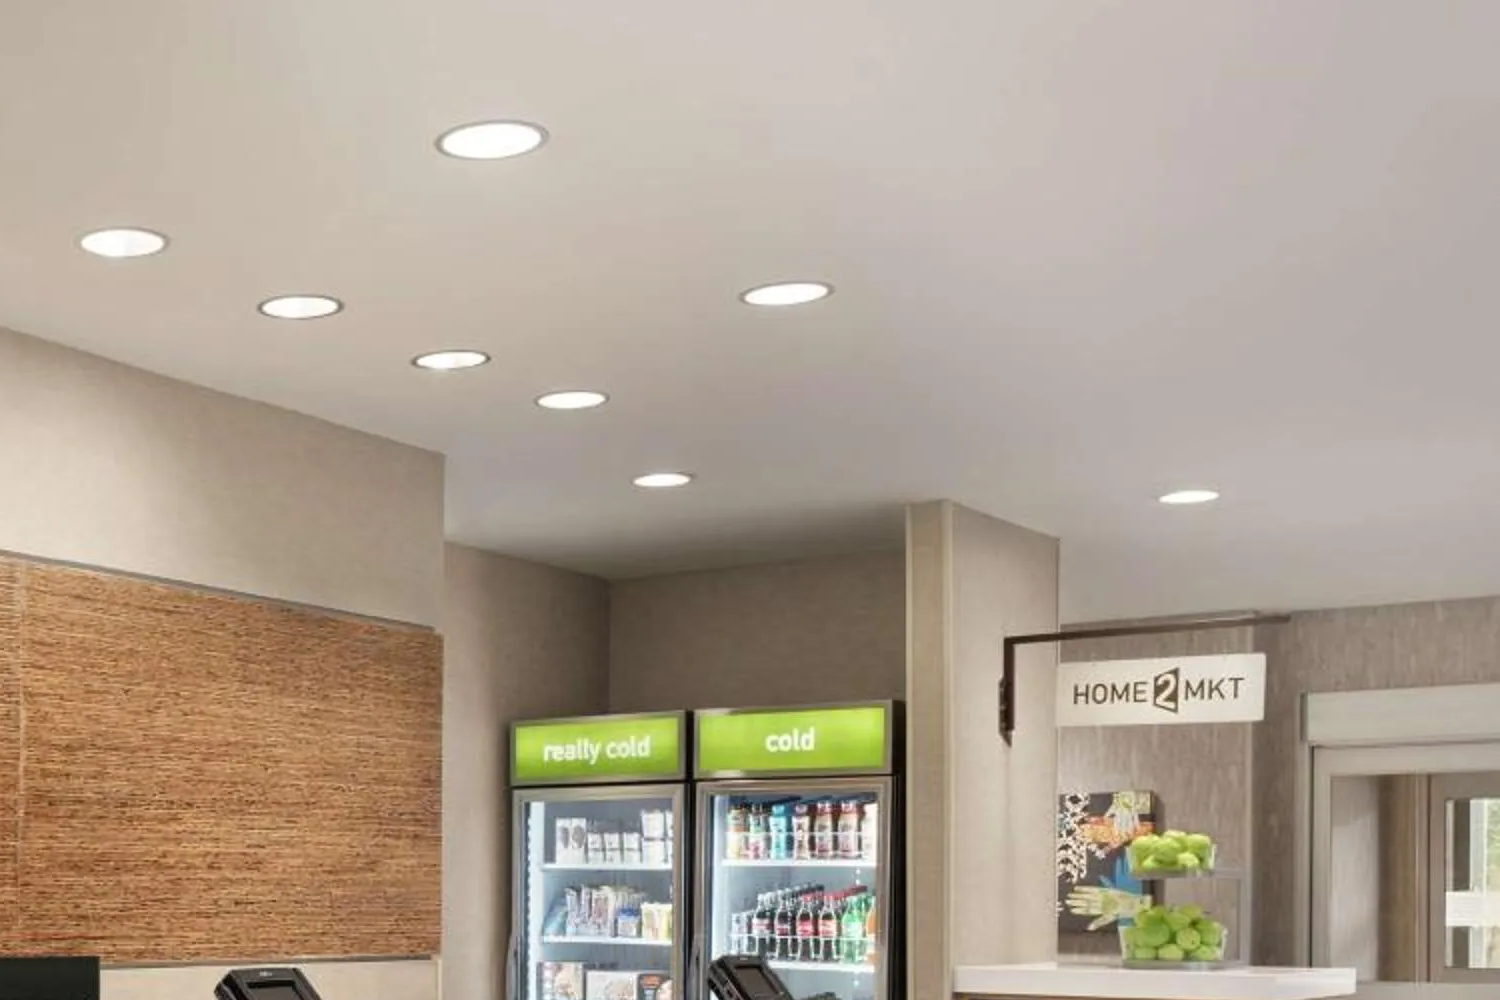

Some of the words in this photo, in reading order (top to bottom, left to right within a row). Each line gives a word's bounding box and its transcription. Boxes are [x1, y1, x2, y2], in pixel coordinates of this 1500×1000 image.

[543, 736, 600, 765] really
[607, 735, 651, 759] cold
[765, 727, 815, 753] cold
